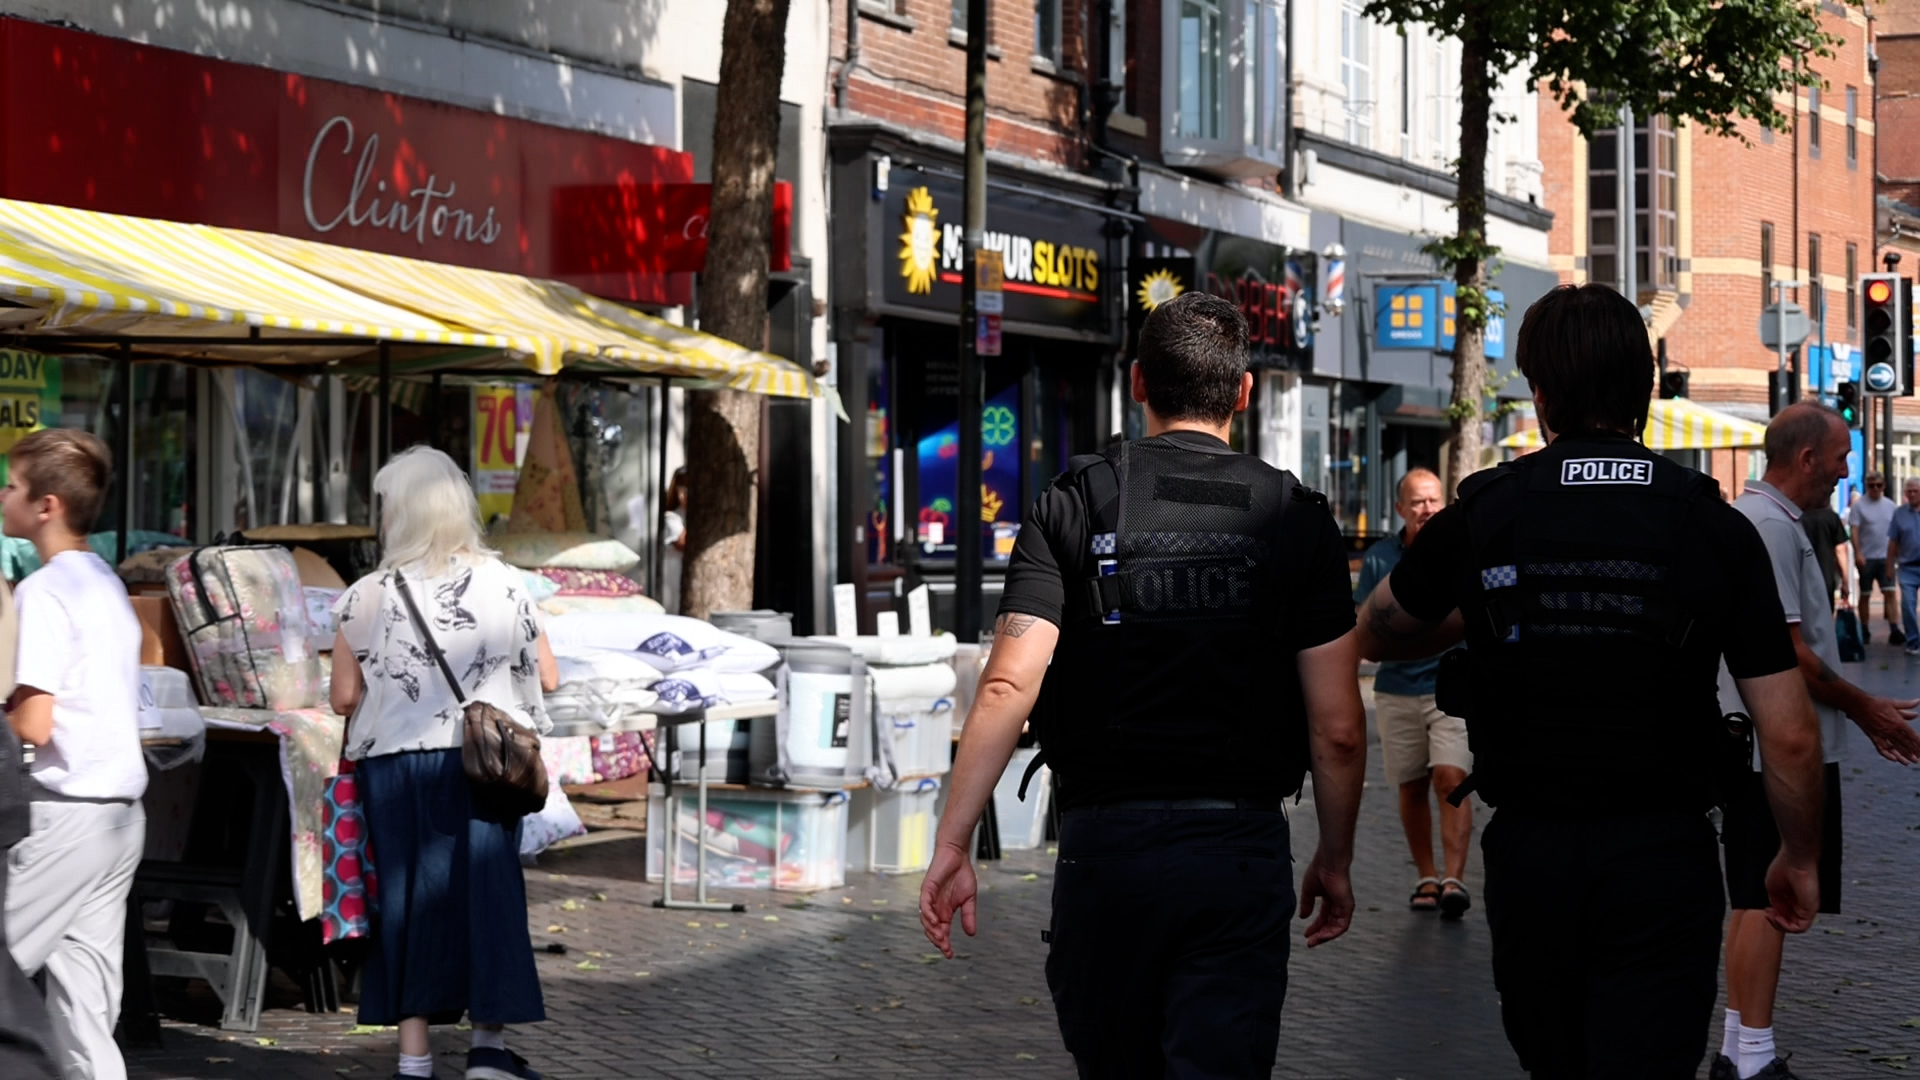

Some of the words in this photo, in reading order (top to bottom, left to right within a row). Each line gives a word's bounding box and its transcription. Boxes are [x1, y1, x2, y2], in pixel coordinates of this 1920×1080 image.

[303, 115, 501, 244] Clintons
[1033, 240, 1099, 291] SLOTS
[0, 352, 41, 379] DAY
[1567, 461, 1646, 481] POLICE
[1136, 566, 1250, 612] OLICE
